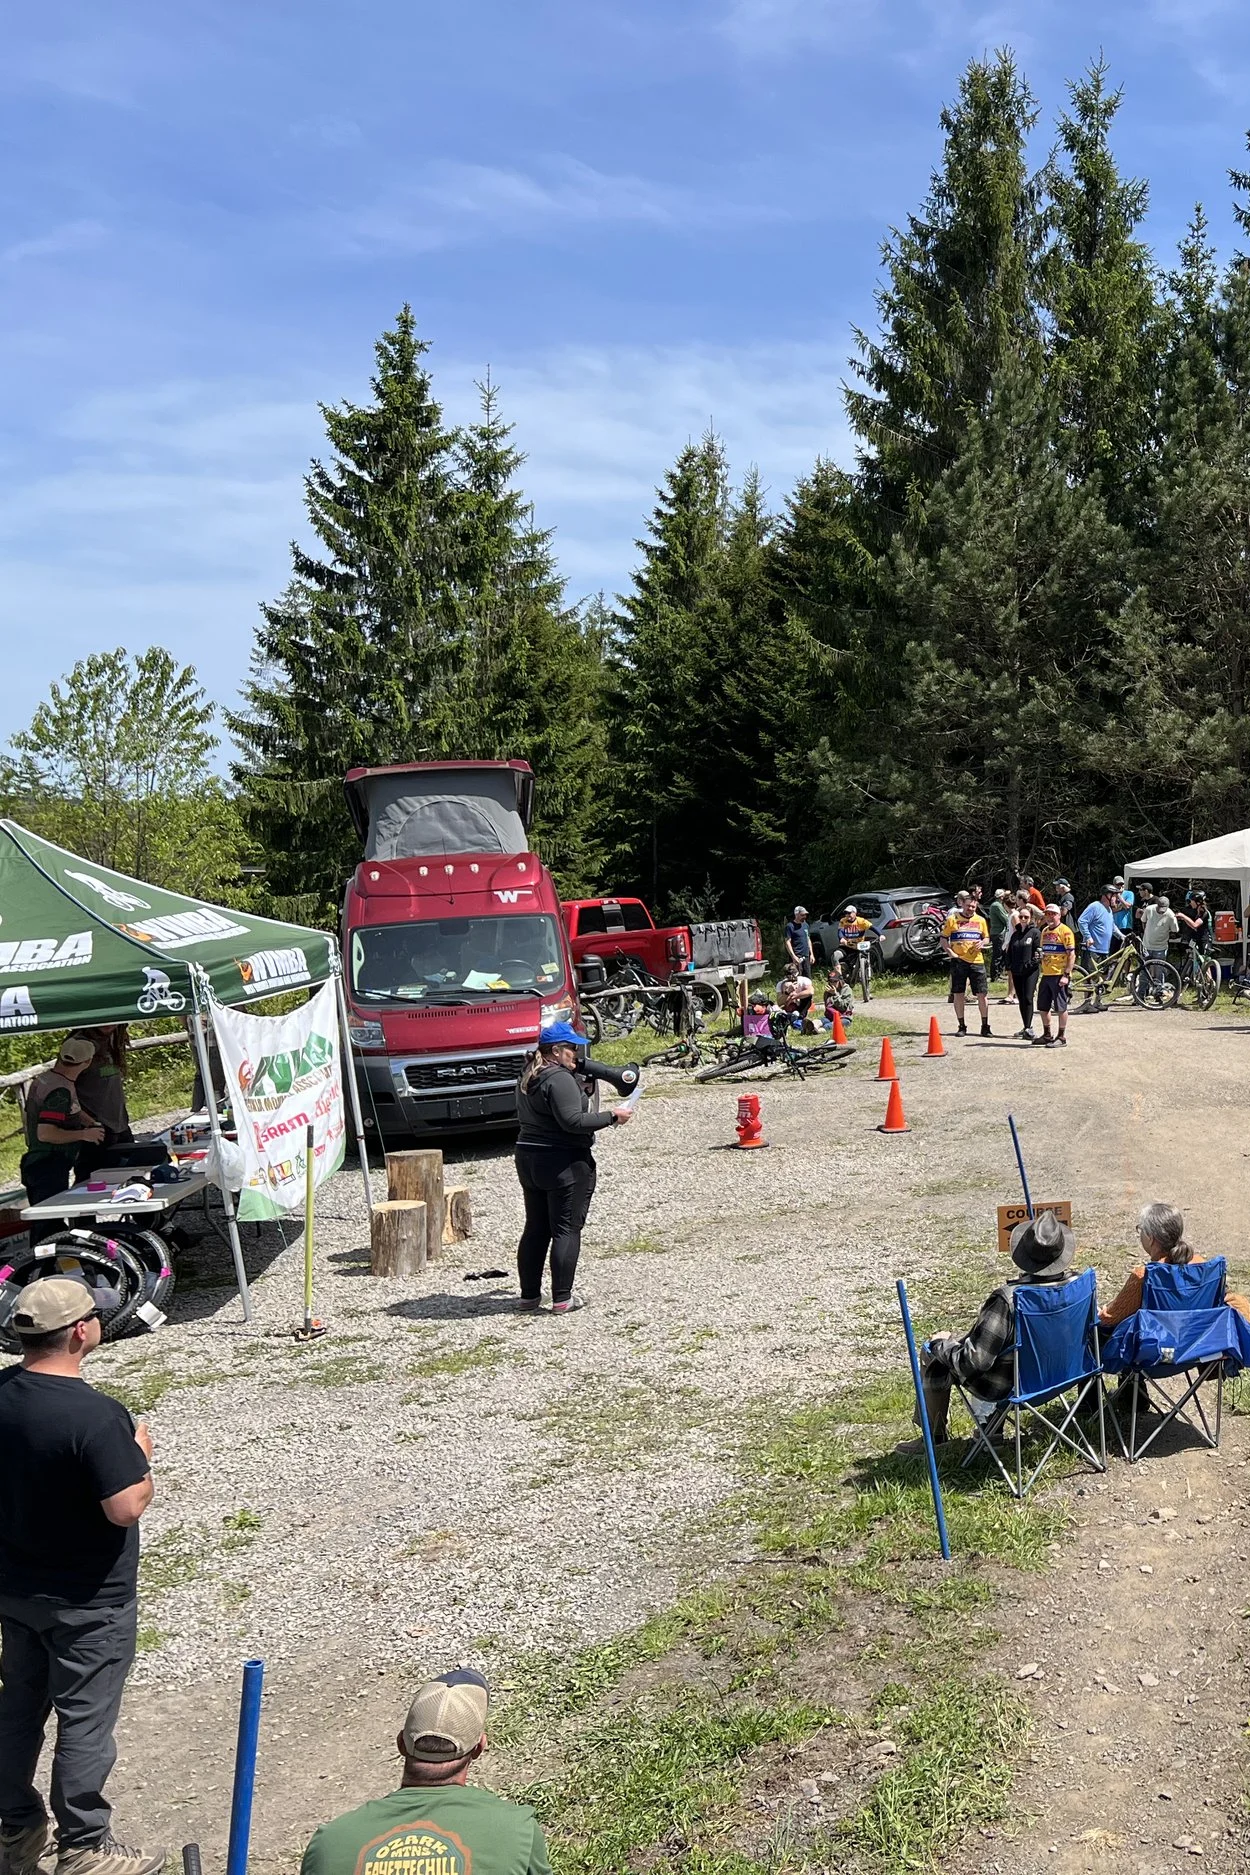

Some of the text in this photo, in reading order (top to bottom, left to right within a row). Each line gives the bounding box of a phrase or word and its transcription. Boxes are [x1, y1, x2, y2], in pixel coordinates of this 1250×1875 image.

[437, 1064, 497, 1078] RAM
[260, 1112, 310, 1143] SRAM
[1006, 1206, 1062, 1219] COURE
[375, 1834, 449, 1859] OZARK
[390, 1845, 435, 1858] MTNS.
[364, 1856, 459, 1875] FAYETTECHILL
